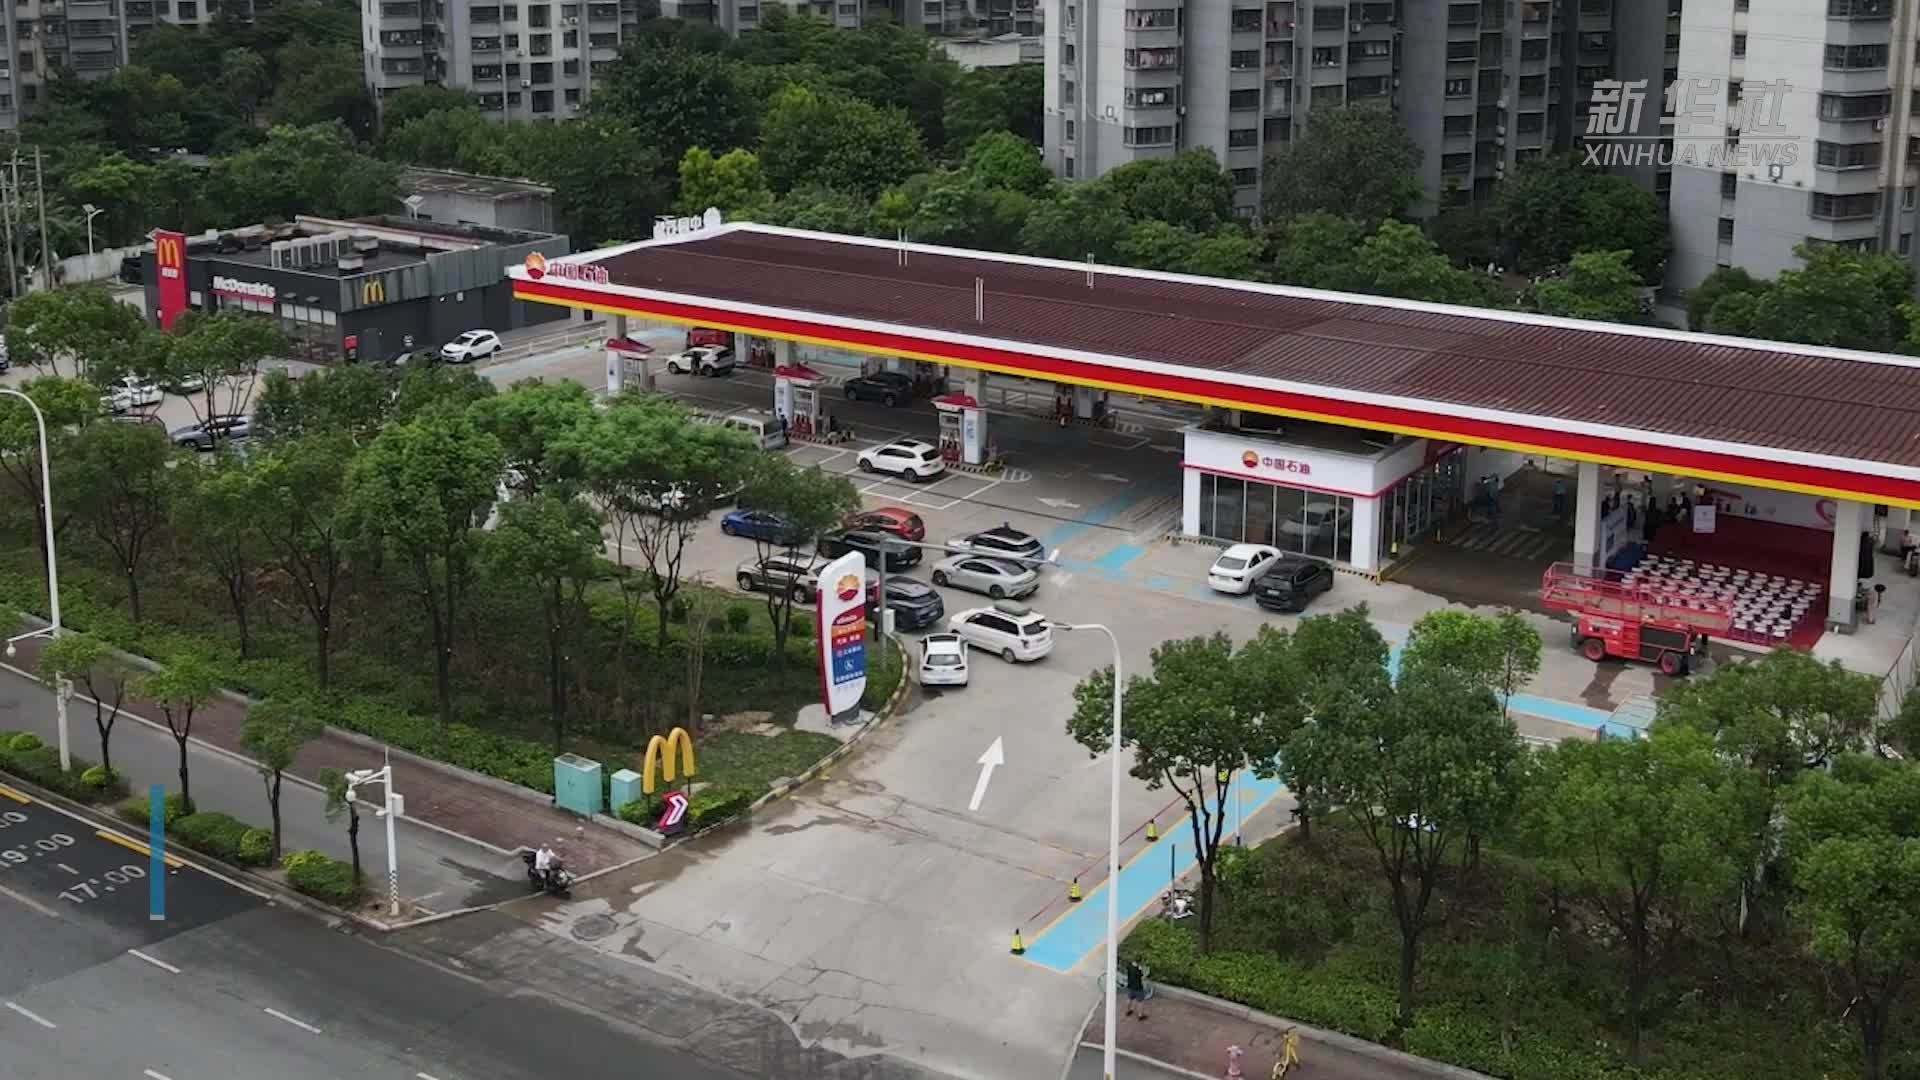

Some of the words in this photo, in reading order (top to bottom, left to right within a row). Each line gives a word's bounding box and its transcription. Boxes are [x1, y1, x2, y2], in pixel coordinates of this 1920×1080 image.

[548, 261, 609, 285] 中国石油
[213, 276, 276, 298] McDonald's
[1262, 456, 1310, 475] 中国石油
[56, 864, 147, 904] 17:00
